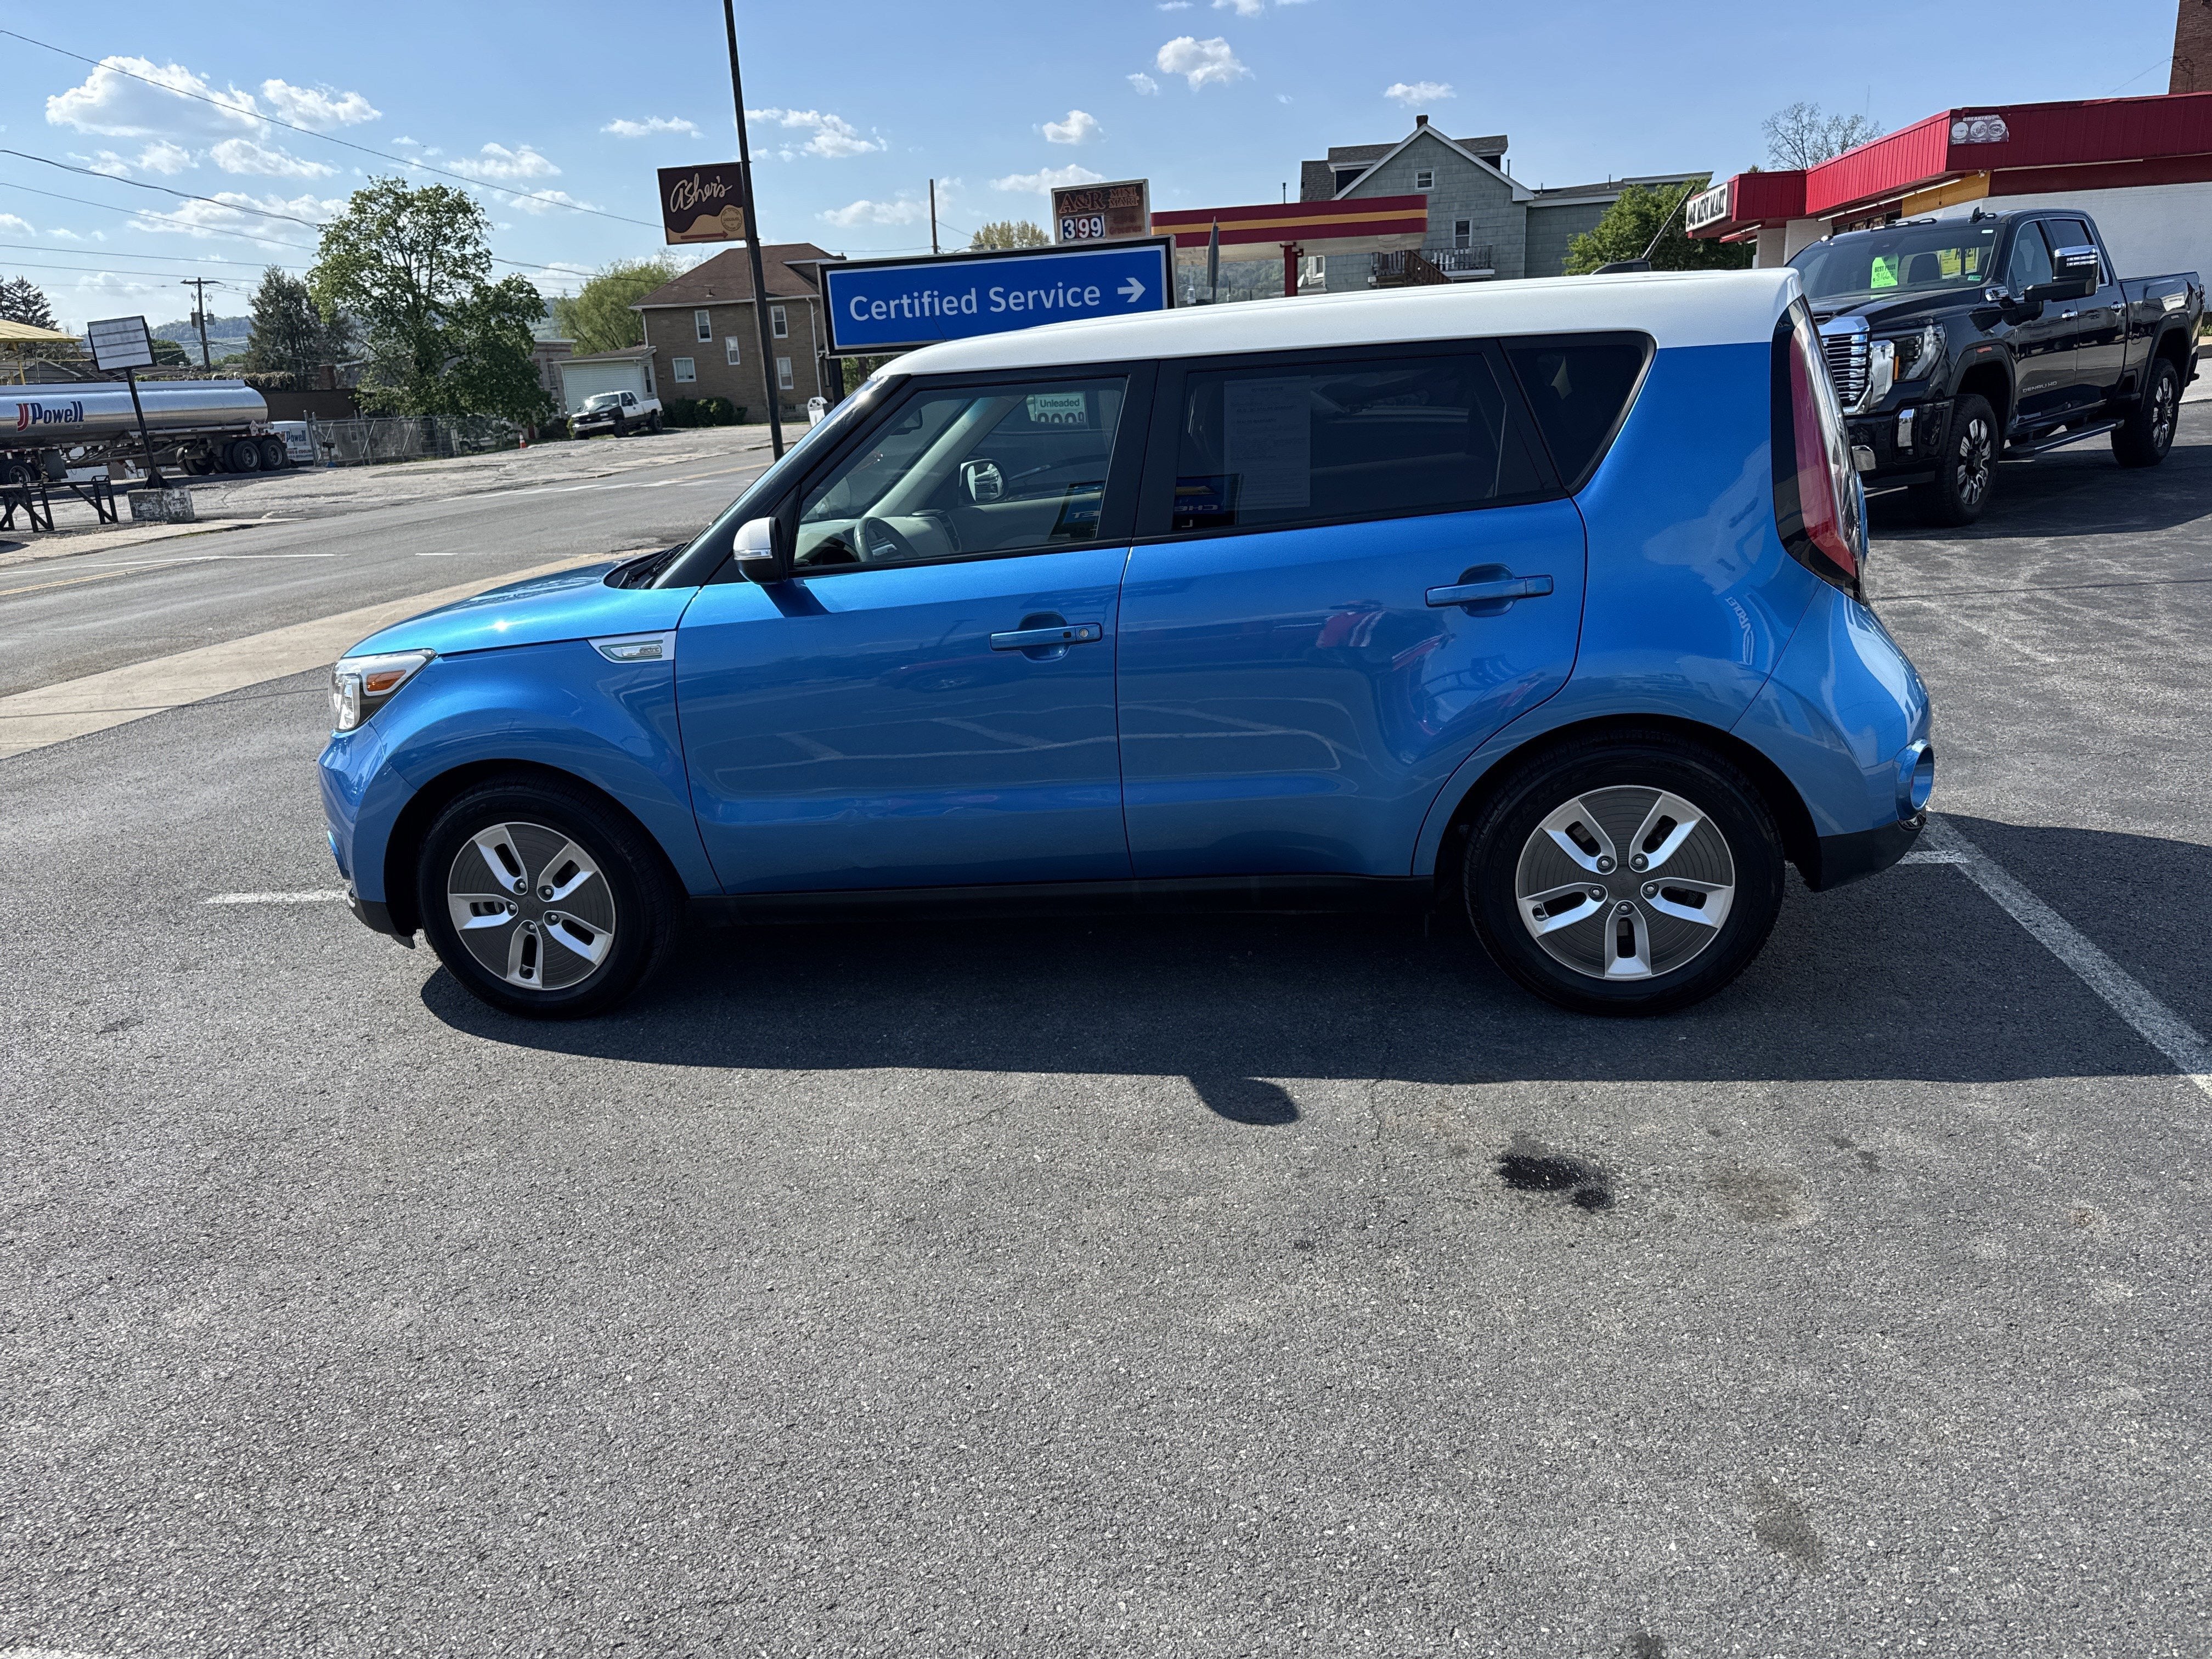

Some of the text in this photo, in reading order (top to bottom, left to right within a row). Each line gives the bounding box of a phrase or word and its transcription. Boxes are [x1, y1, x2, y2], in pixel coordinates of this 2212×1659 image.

[670, 173, 733, 213] Asher's
[1059, 191, 1106, 213] A&R
[1108, 196, 1139, 208] MART
[849, 281, 1101, 321] Certified Service
[30, 400, 84, 425] Powell
[1040, 398, 1080, 408] Unleaded
[286, 430, 307, 442] Powell
